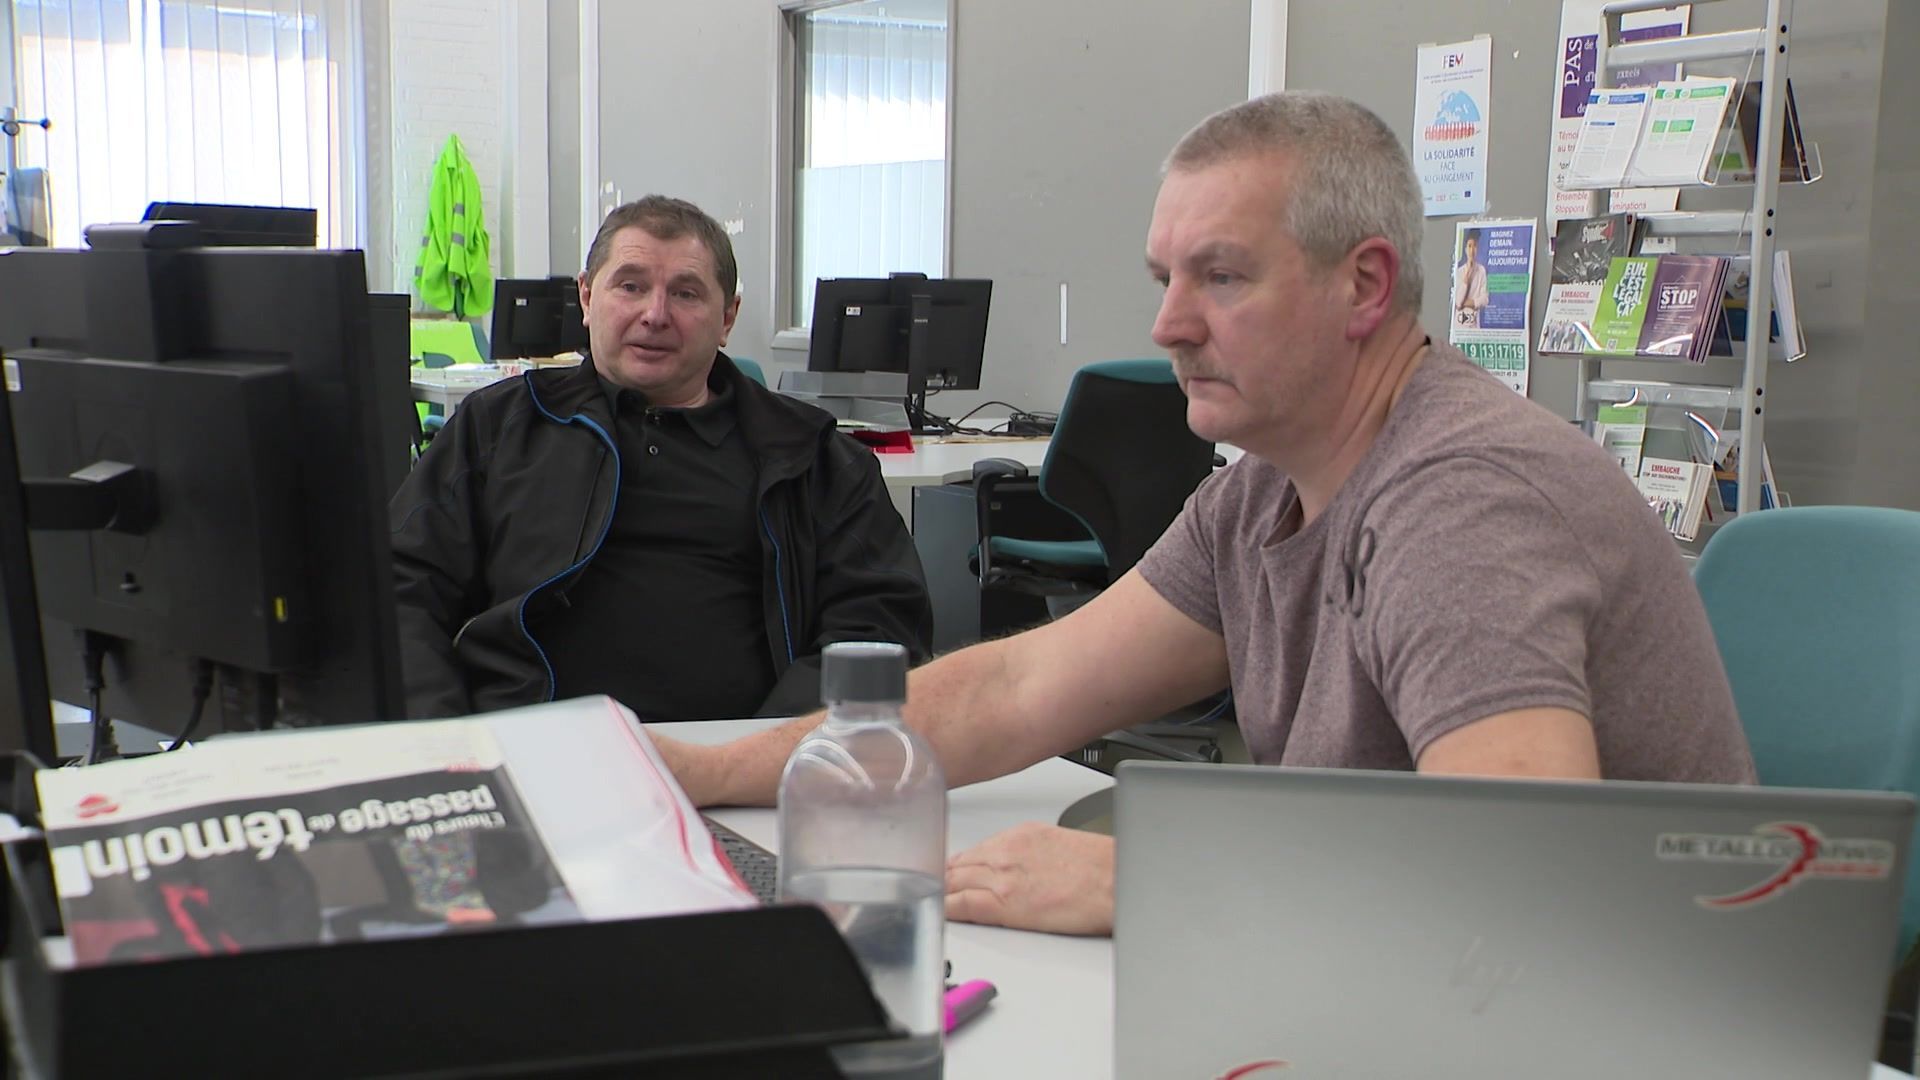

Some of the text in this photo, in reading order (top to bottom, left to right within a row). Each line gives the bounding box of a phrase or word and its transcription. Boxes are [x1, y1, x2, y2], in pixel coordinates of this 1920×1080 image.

[1443, 53, 1465, 70] FEM
[1564, 38, 1583, 87] PAS
[1424, 147, 1475, 161] LA SOLIDARITÉ
[1440, 162, 1455, 171] FACE
[1433, 171, 1474, 183] CHANGEMENT
[1556, 192, 1588, 201] Ensemble
[1625, 261, 1648, 277] EUH
[1660, 288, 1698, 305] STOP
[1469, 344, 1524, 358] 9 13 17 19
[1651, 464, 1680, 475] EMBAUCHE
[83, 784, 497, 883] passage de témoin
[404, 822, 434, 842] du
